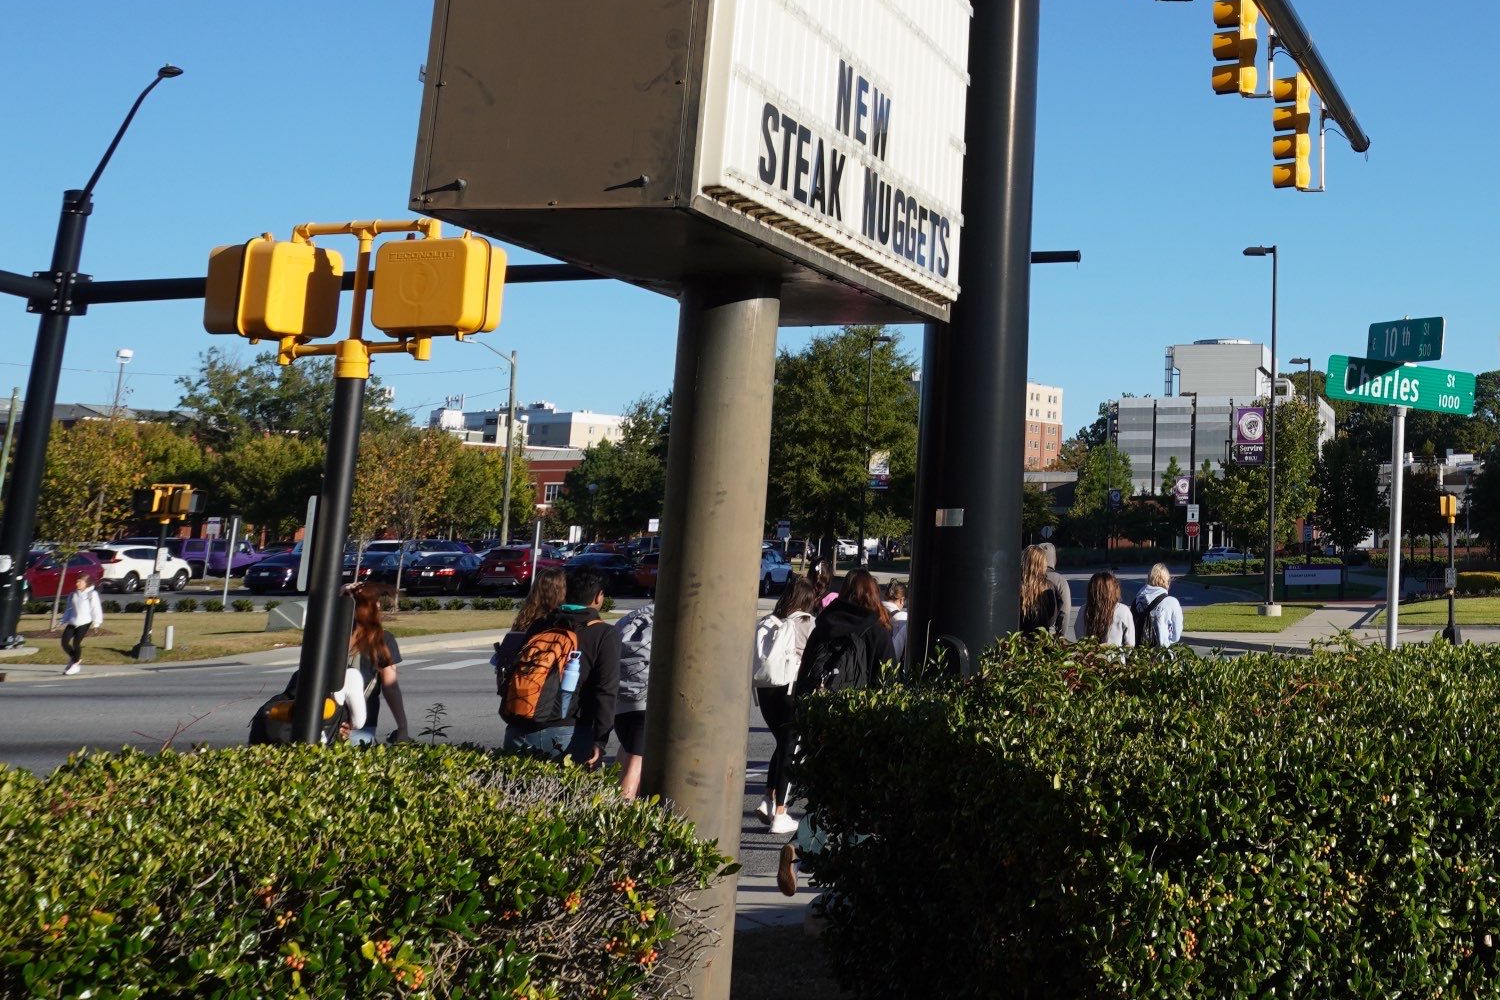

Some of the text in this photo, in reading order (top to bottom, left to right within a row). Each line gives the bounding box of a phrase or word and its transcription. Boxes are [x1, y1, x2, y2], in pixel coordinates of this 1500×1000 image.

[836, 59, 891, 162] NEW
[758, 102, 950, 278] STEAK NUGGETS
[1423, 322, 1430, 336] St
[1419, 343, 1432, 357] 500
[1344, 363, 1455, 402] Charles St
[1438, 394, 1460, 410] 1000
[1186, 525, 1200, 533] STOP
